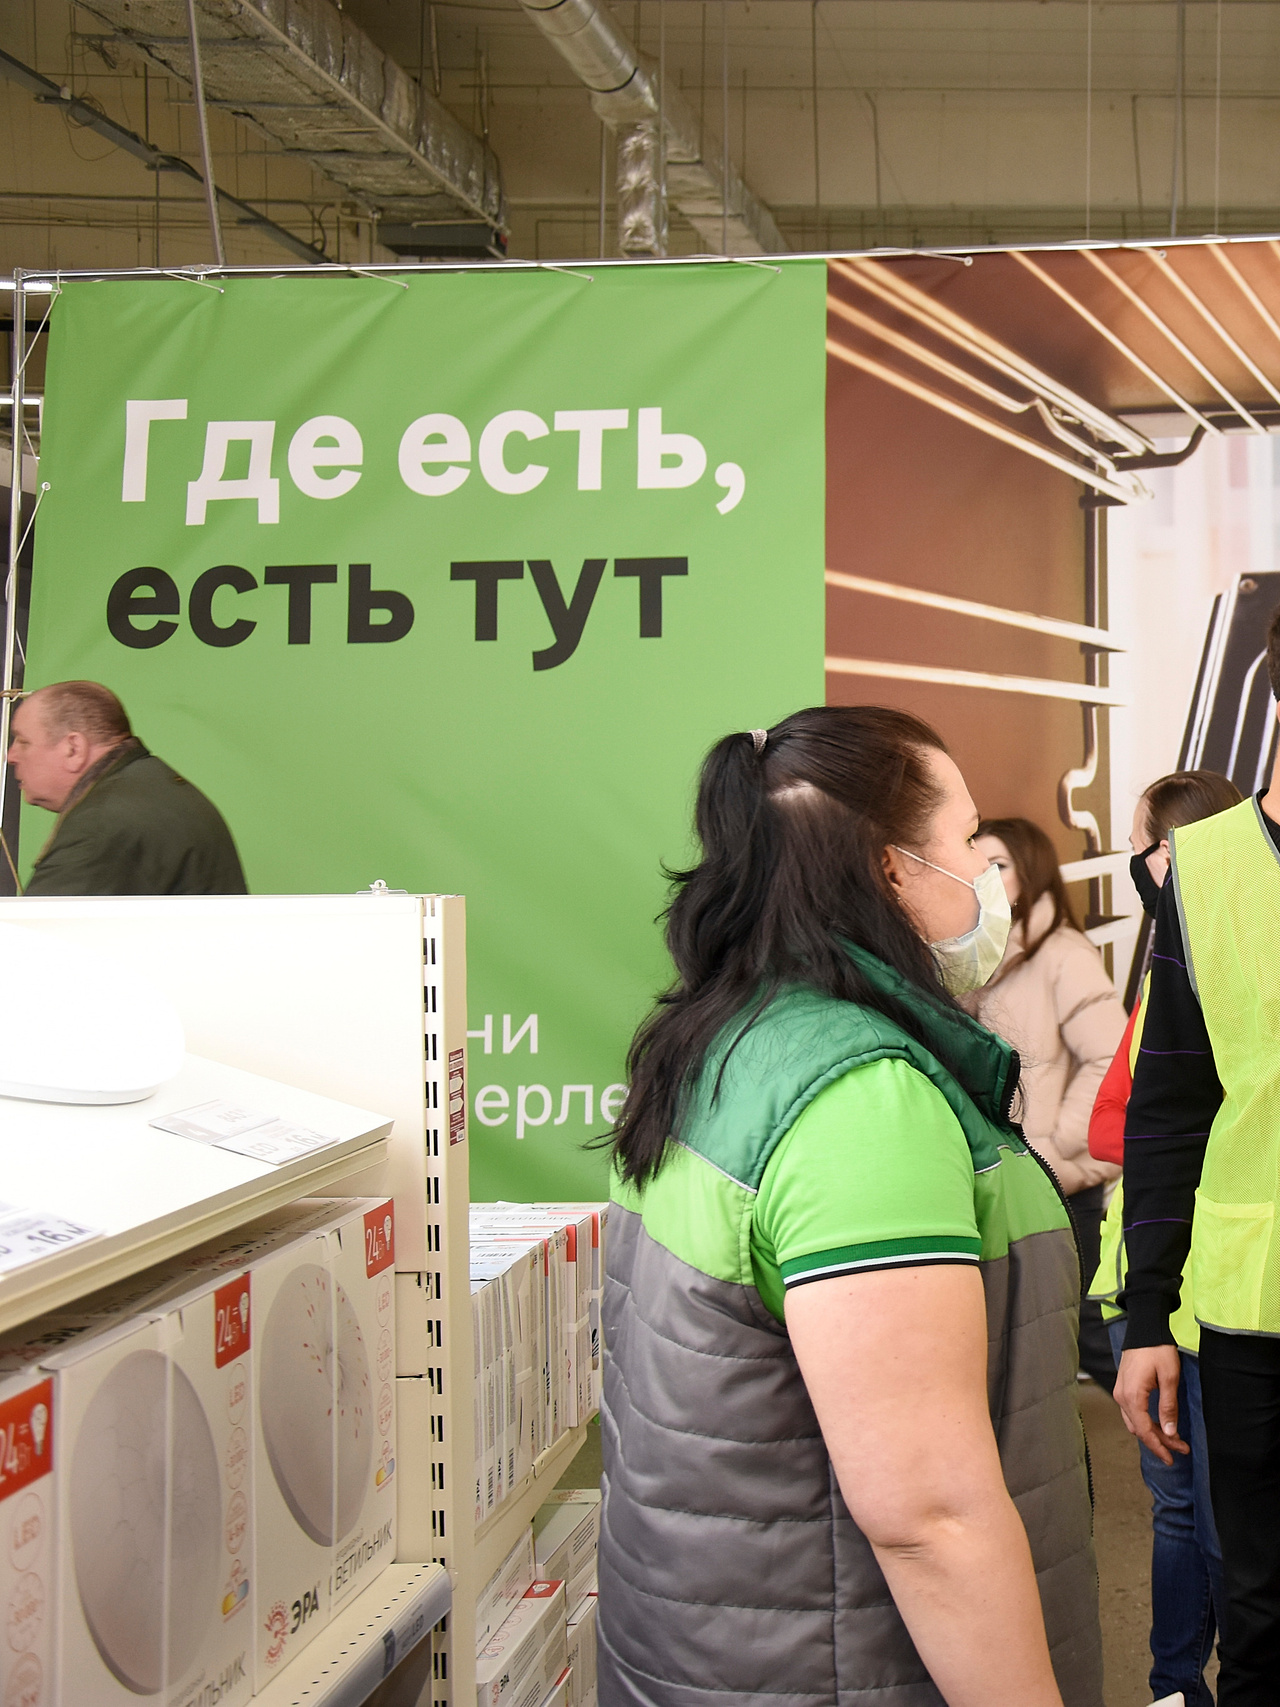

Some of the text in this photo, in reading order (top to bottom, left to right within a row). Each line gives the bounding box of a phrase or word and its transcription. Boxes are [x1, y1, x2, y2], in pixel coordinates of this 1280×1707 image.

[122, 398, 747, 526] Где есть,
[105, 556, 689, 672] есть тут
[466, 1013, 539, 1055] ни
[474, 1083, 630, 1139] ерле
[27, 1229, 75, 1246] 16
[290, 1585, 320, 1635] ЭРА
